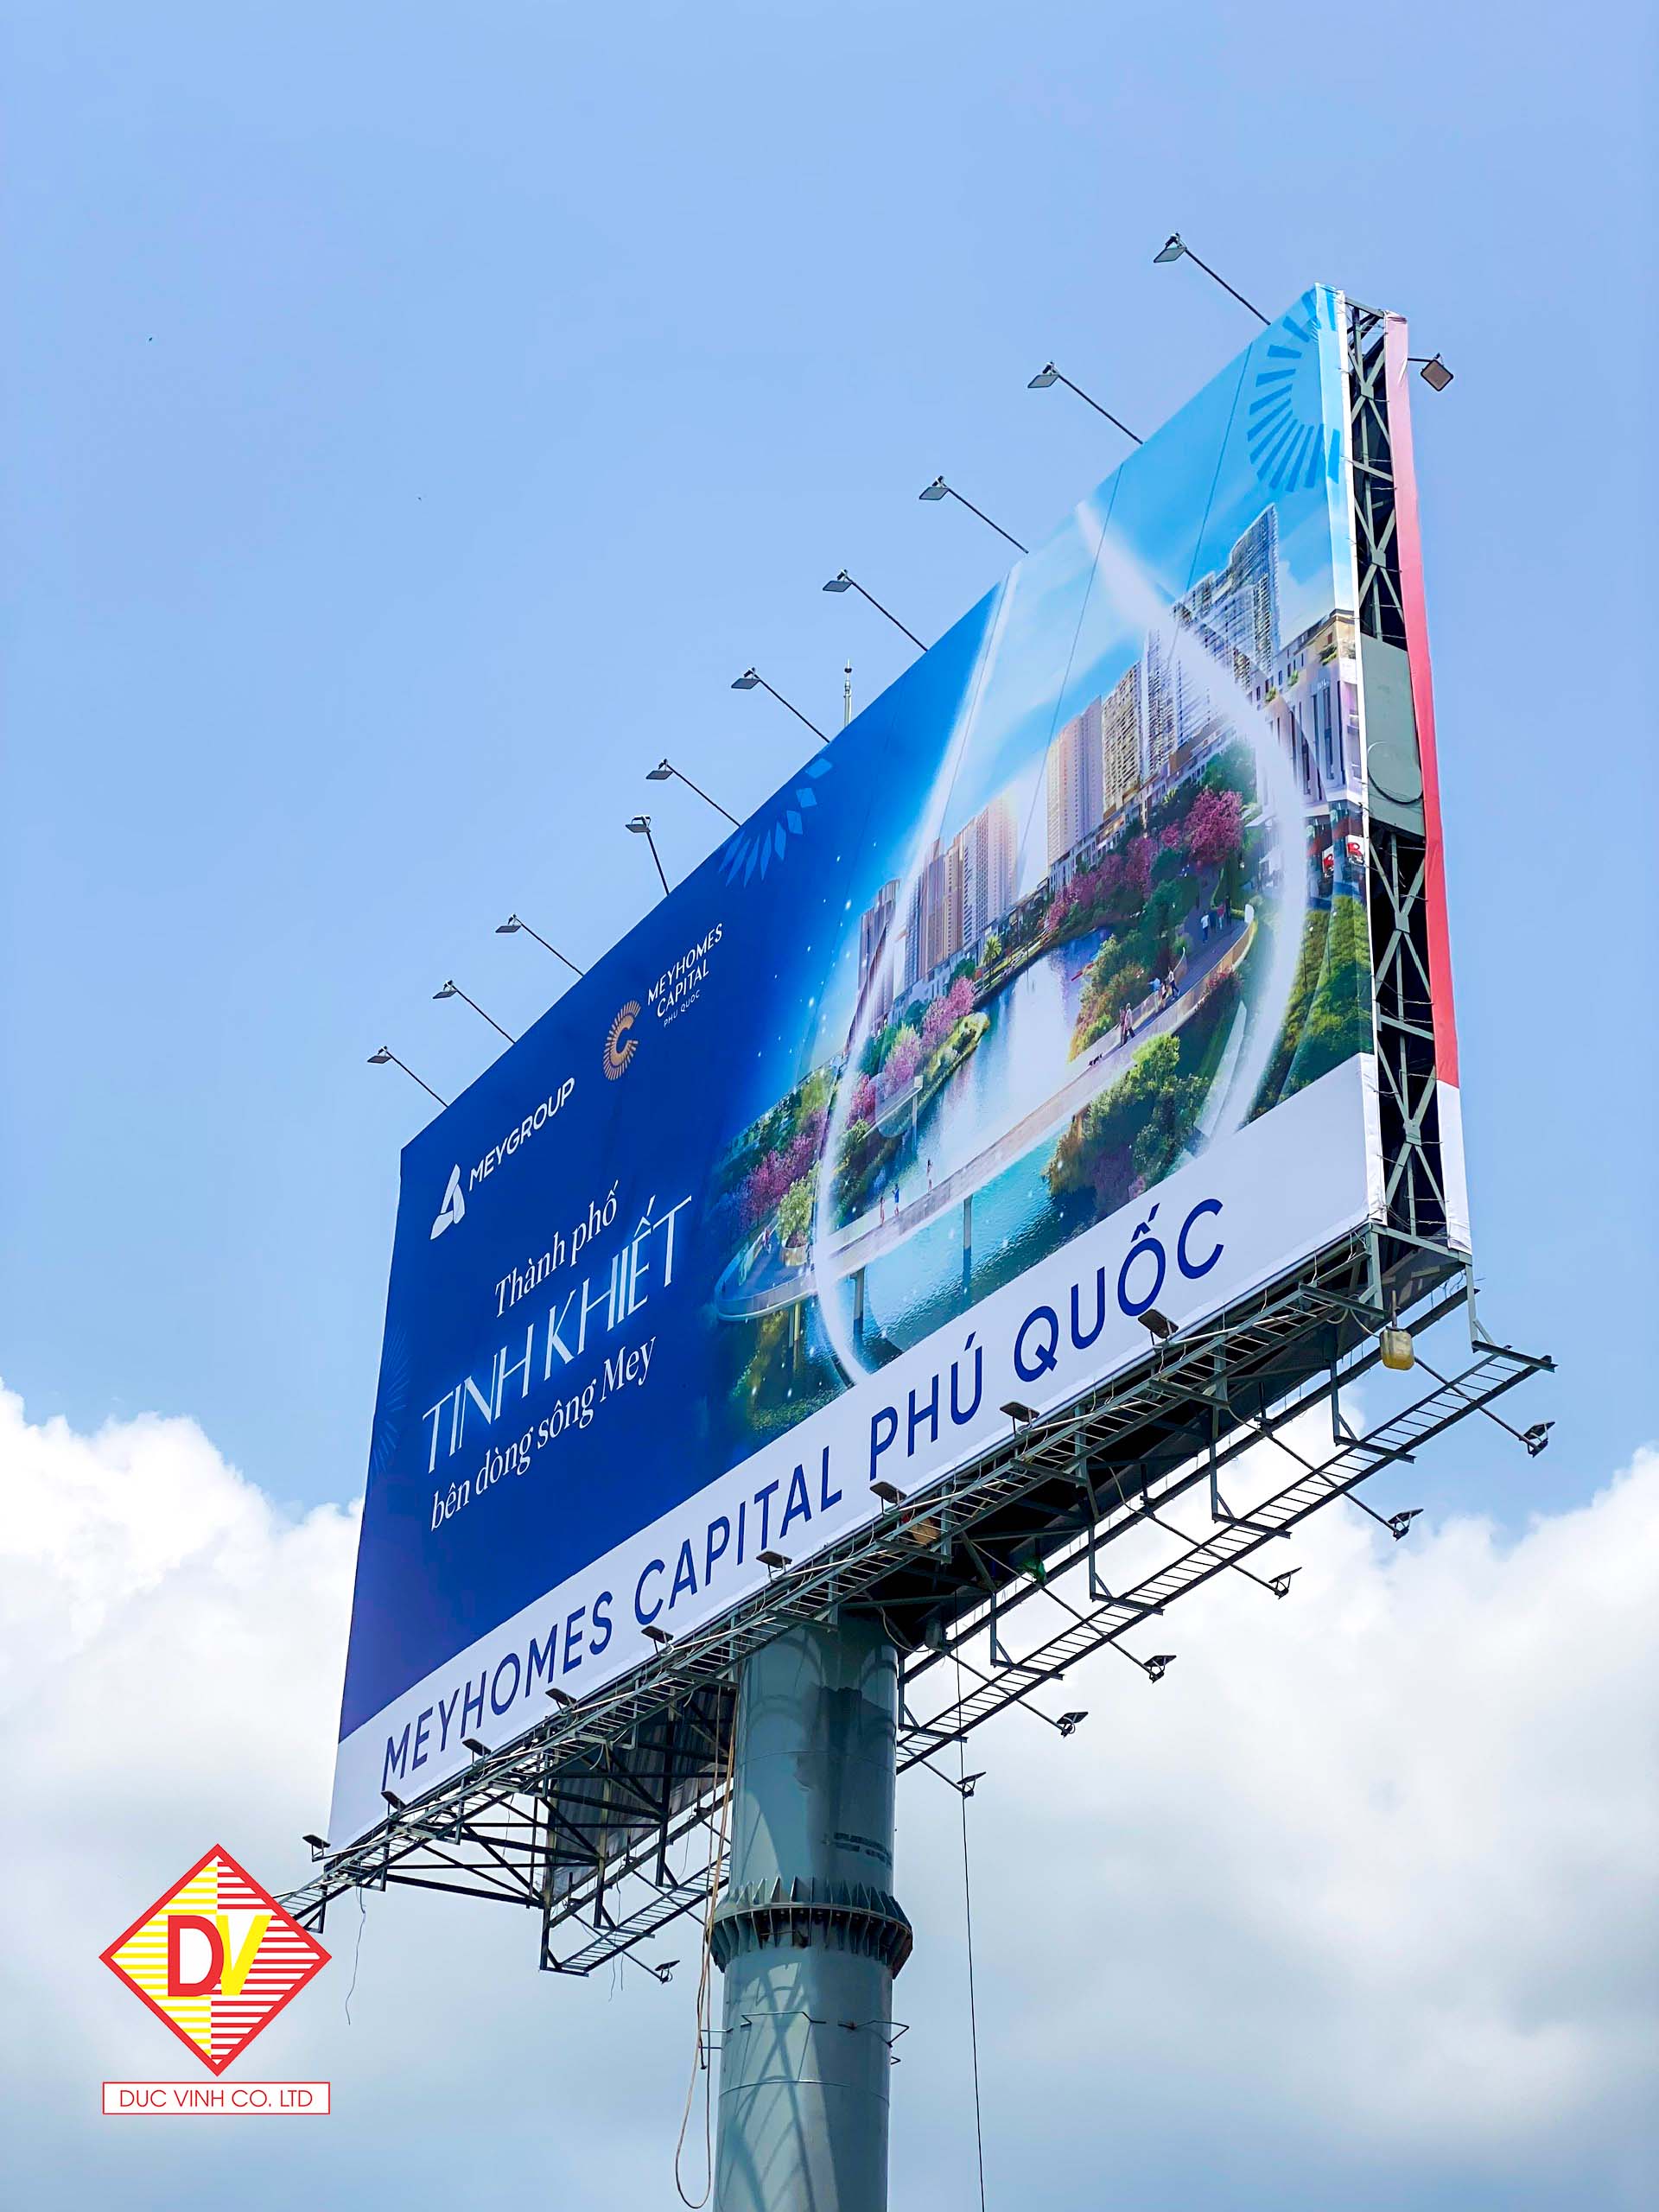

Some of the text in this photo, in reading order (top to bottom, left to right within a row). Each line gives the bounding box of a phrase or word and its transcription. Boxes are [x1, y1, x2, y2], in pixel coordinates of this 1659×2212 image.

[647, 922, 722, 1006] MEYHOMES
[657, 958, 709, 1017] CAPITAL
[468, 1077, 575, 1191] MEYGROUP
[494, 1179, 619, 1319] Thành phố
[422, 1193, 692, 1474] TINH KHIẾT
[383, 1198, 1224, 1791] MEYHOMES CAPITAL PHÚ QUỐC
[430, 1336, 657, 1531] bên dòng sông Mey
